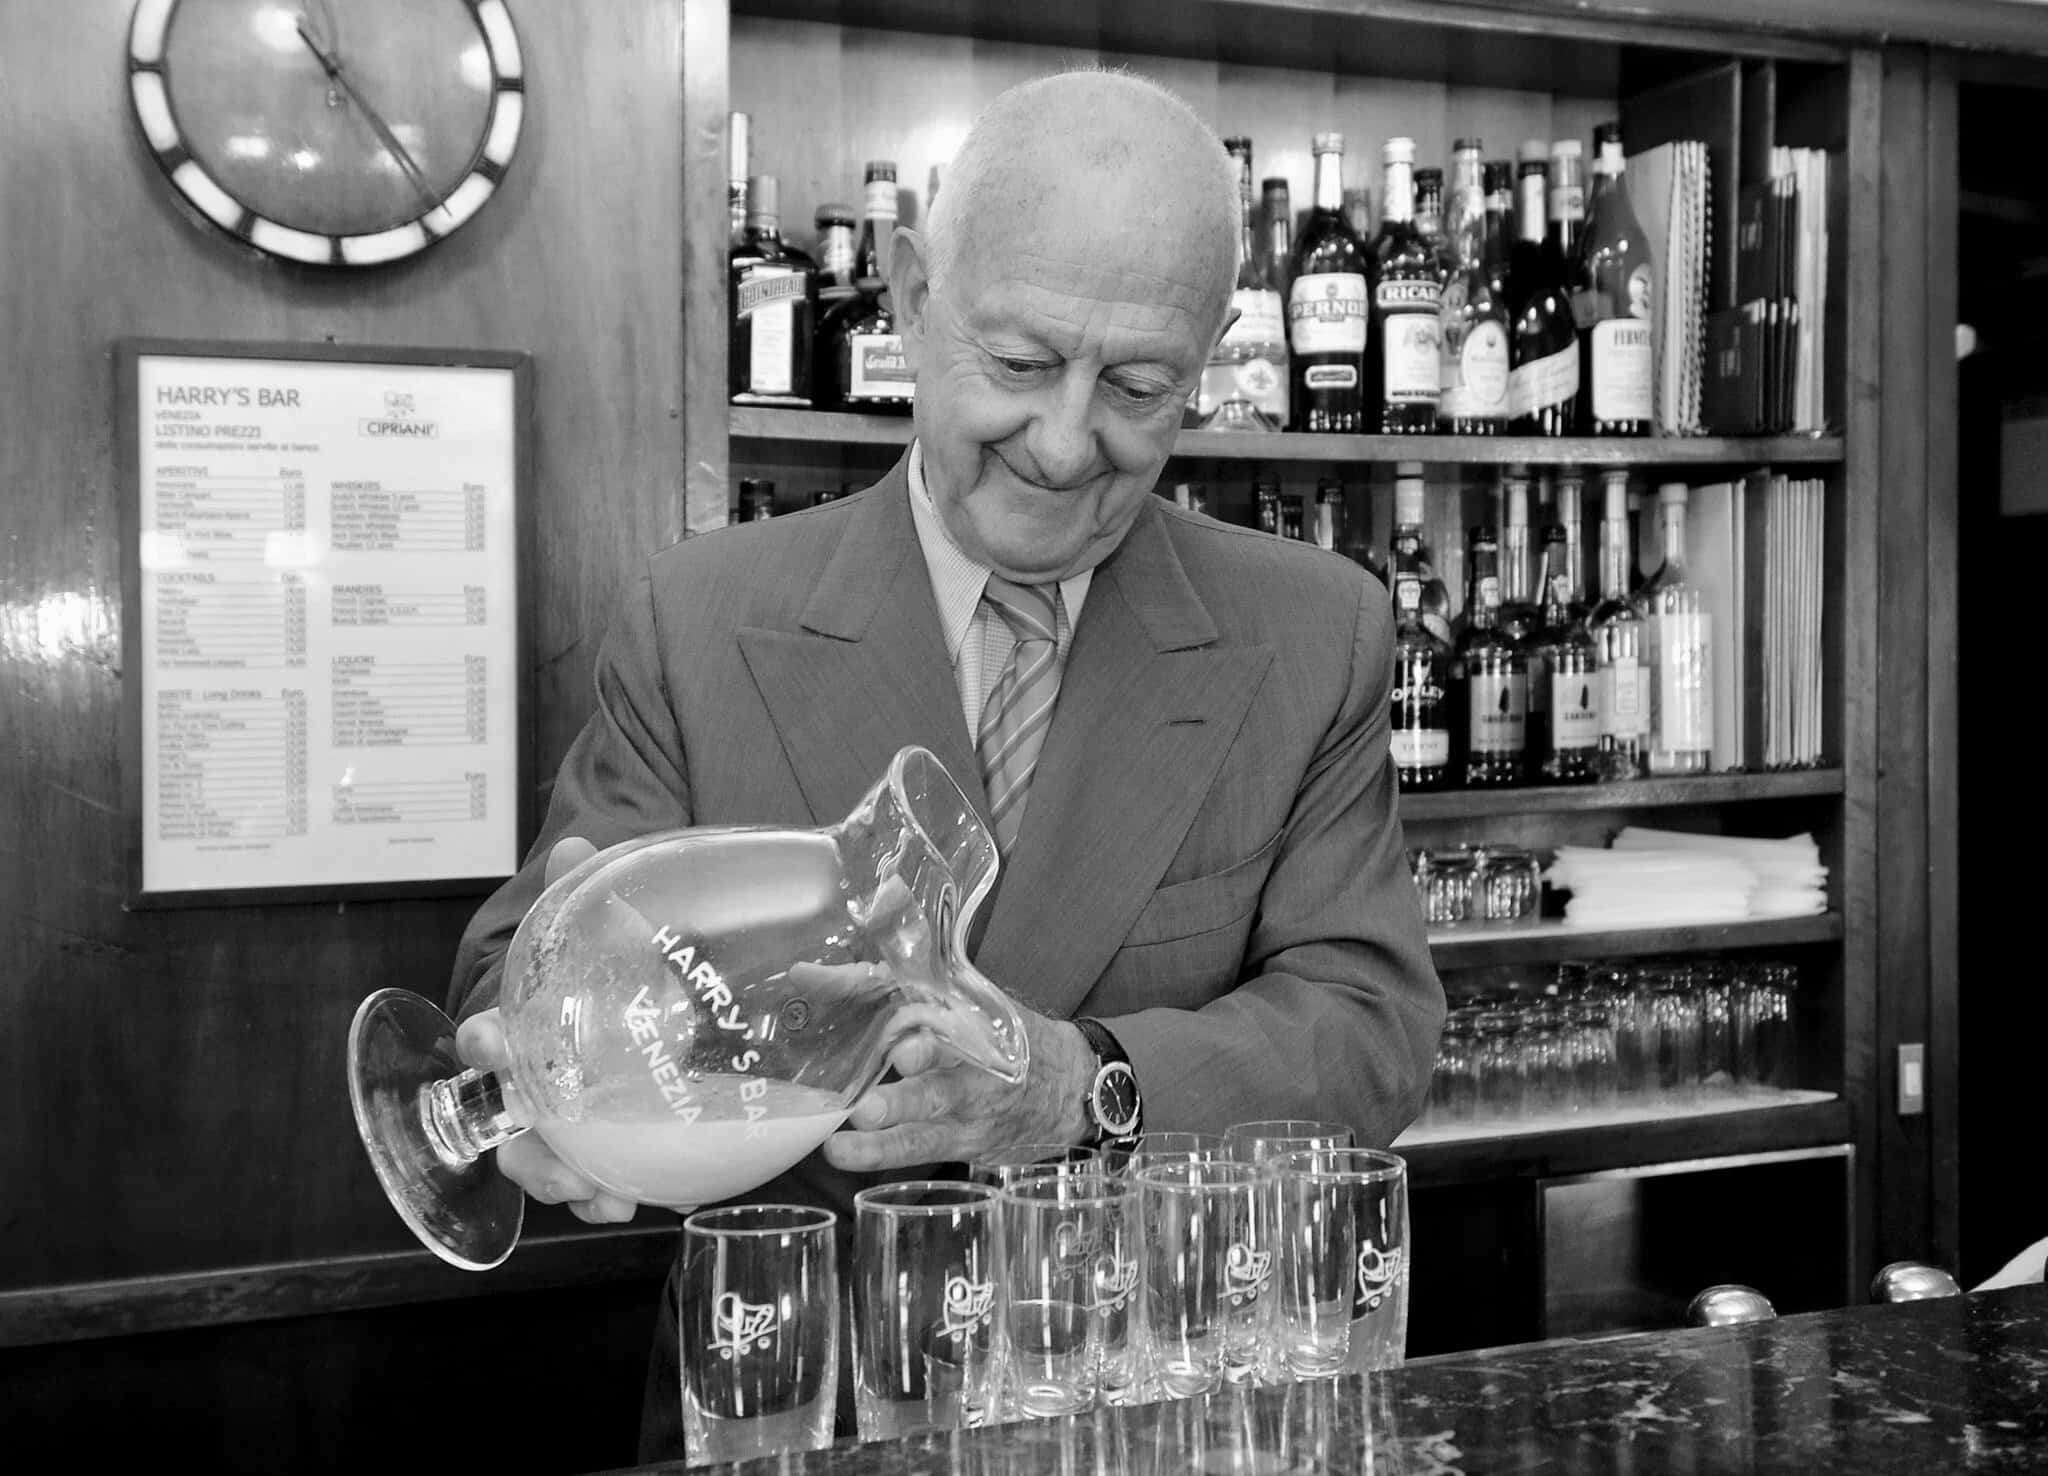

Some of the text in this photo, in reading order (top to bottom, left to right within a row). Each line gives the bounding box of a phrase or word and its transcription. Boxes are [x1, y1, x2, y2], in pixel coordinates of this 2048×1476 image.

[156, 385, 301, 407] HARRY'S BAR
[155, 424, 261, 438] LISTINO PREZZI
[366, 421, 432, 436] CIPRIANI
